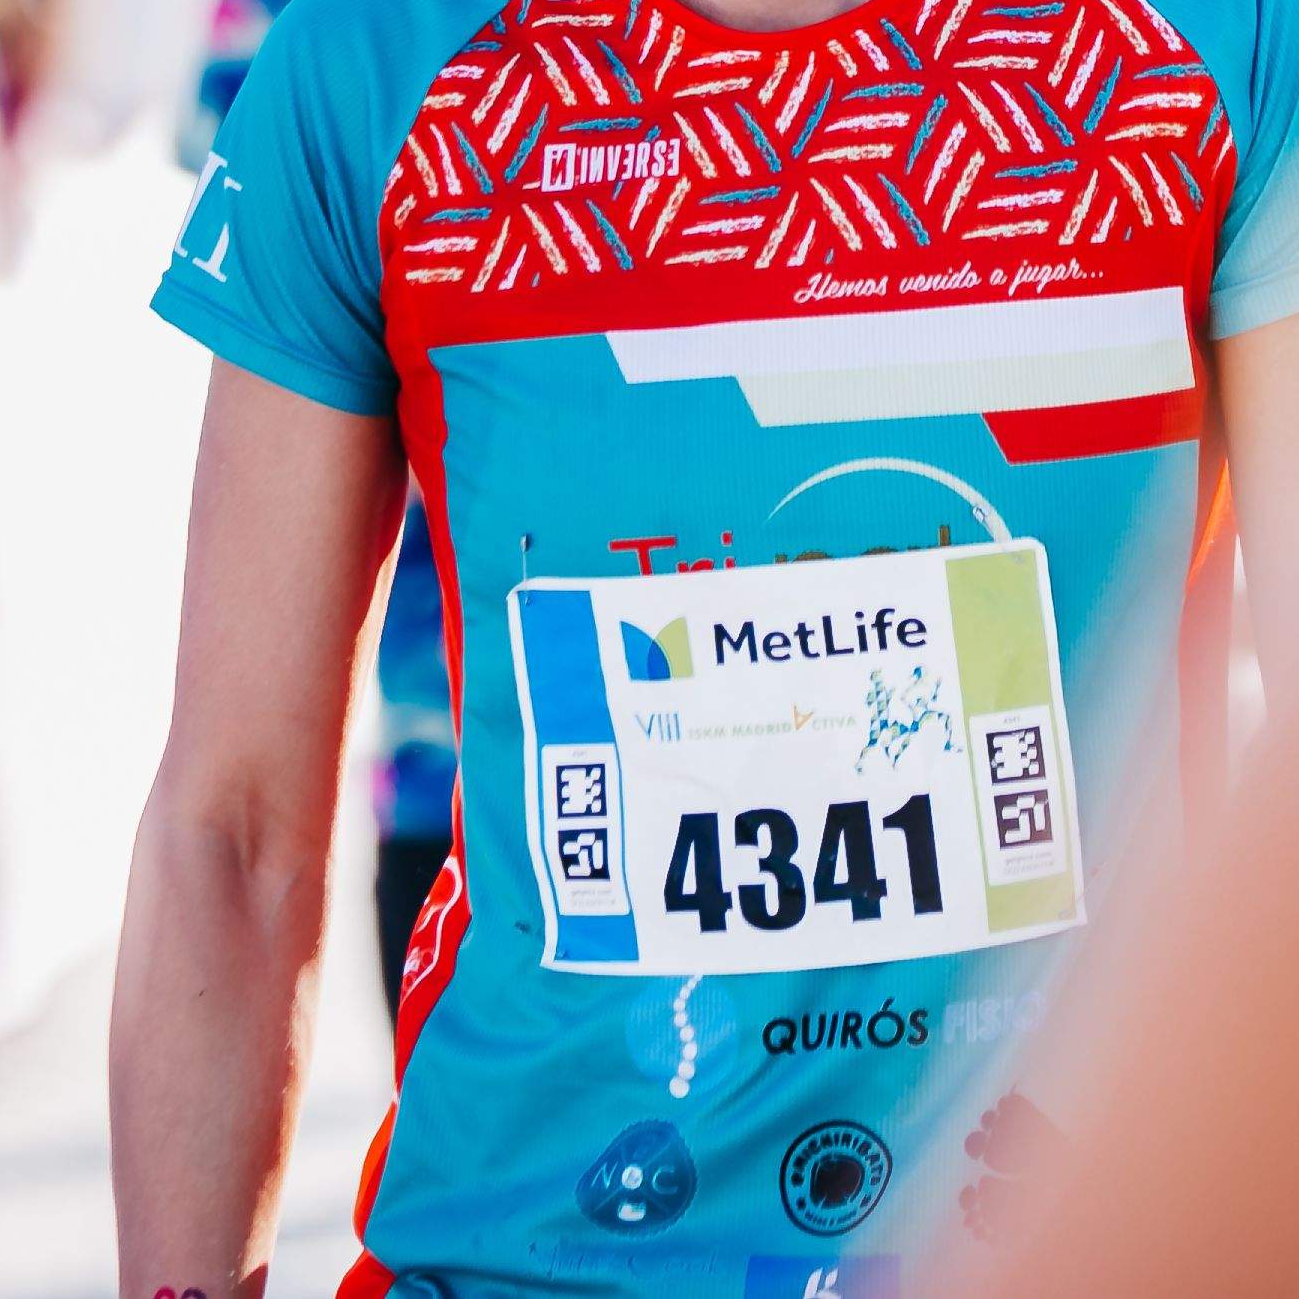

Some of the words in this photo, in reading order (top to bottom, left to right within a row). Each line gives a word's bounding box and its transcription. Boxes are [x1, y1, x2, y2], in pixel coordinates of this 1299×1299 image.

[899, 260, 982, 294] venido
[989, 267, 1007, 286] a
[713, 607, 928, 666] MetLife
[634, 711, 682, 742] VIII
[663, 793, 944, 935] 4341
[762, 996, 930, 1055] QUIRÓS
